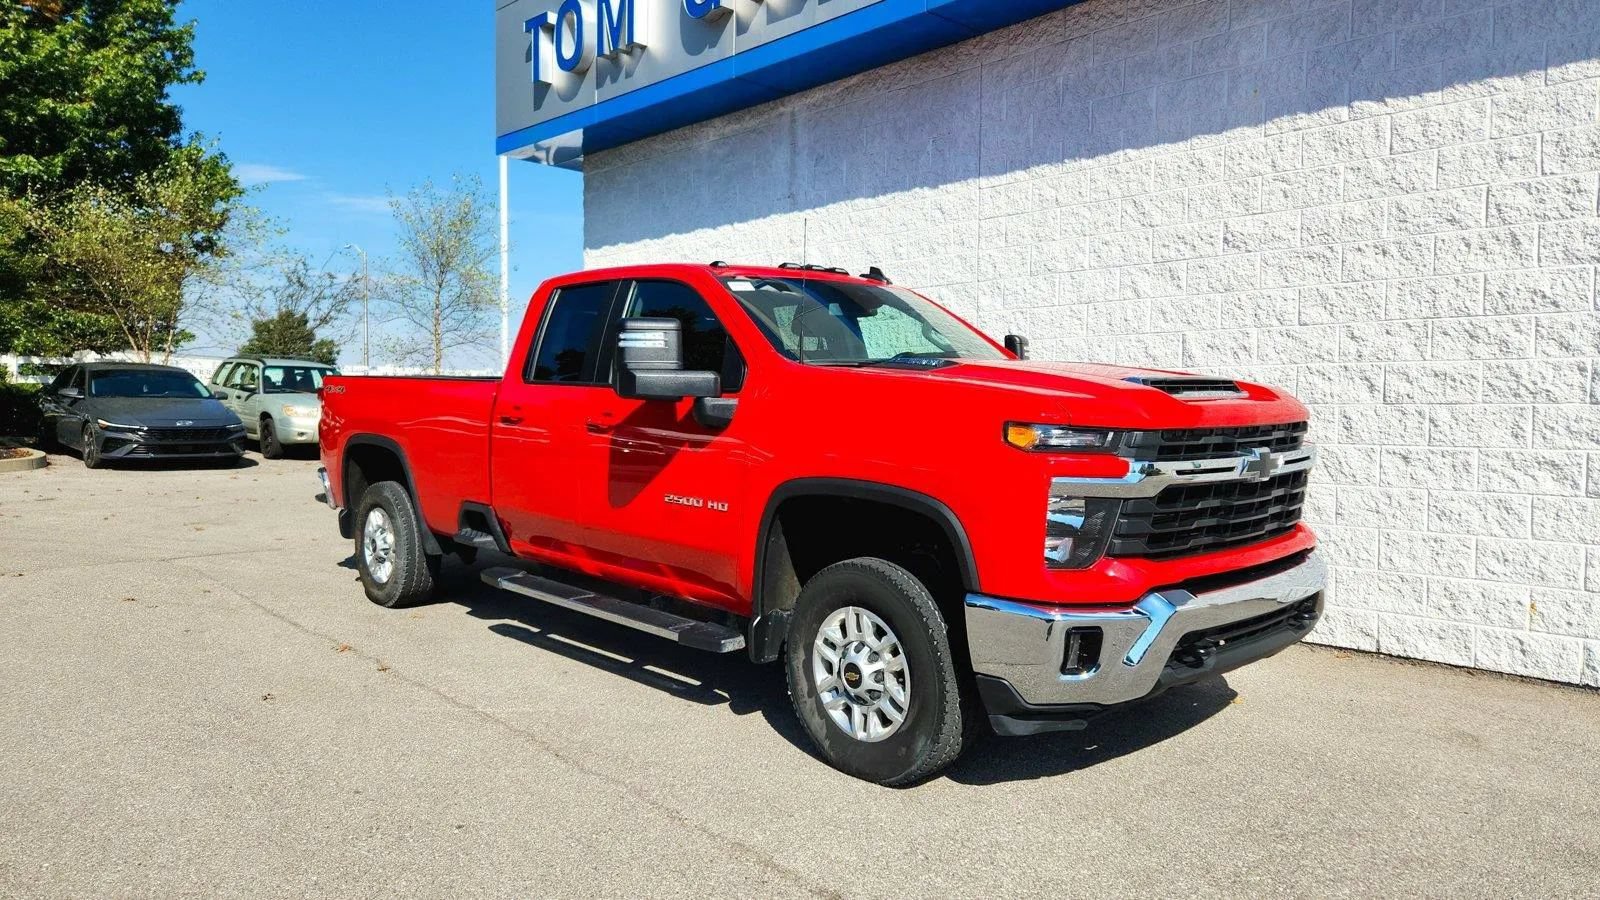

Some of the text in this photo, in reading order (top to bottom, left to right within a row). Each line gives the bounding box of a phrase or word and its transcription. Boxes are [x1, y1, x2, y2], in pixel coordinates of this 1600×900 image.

[523, 0, 636, 83] TOM
[664, 494, 728, 511] 2500 HD
